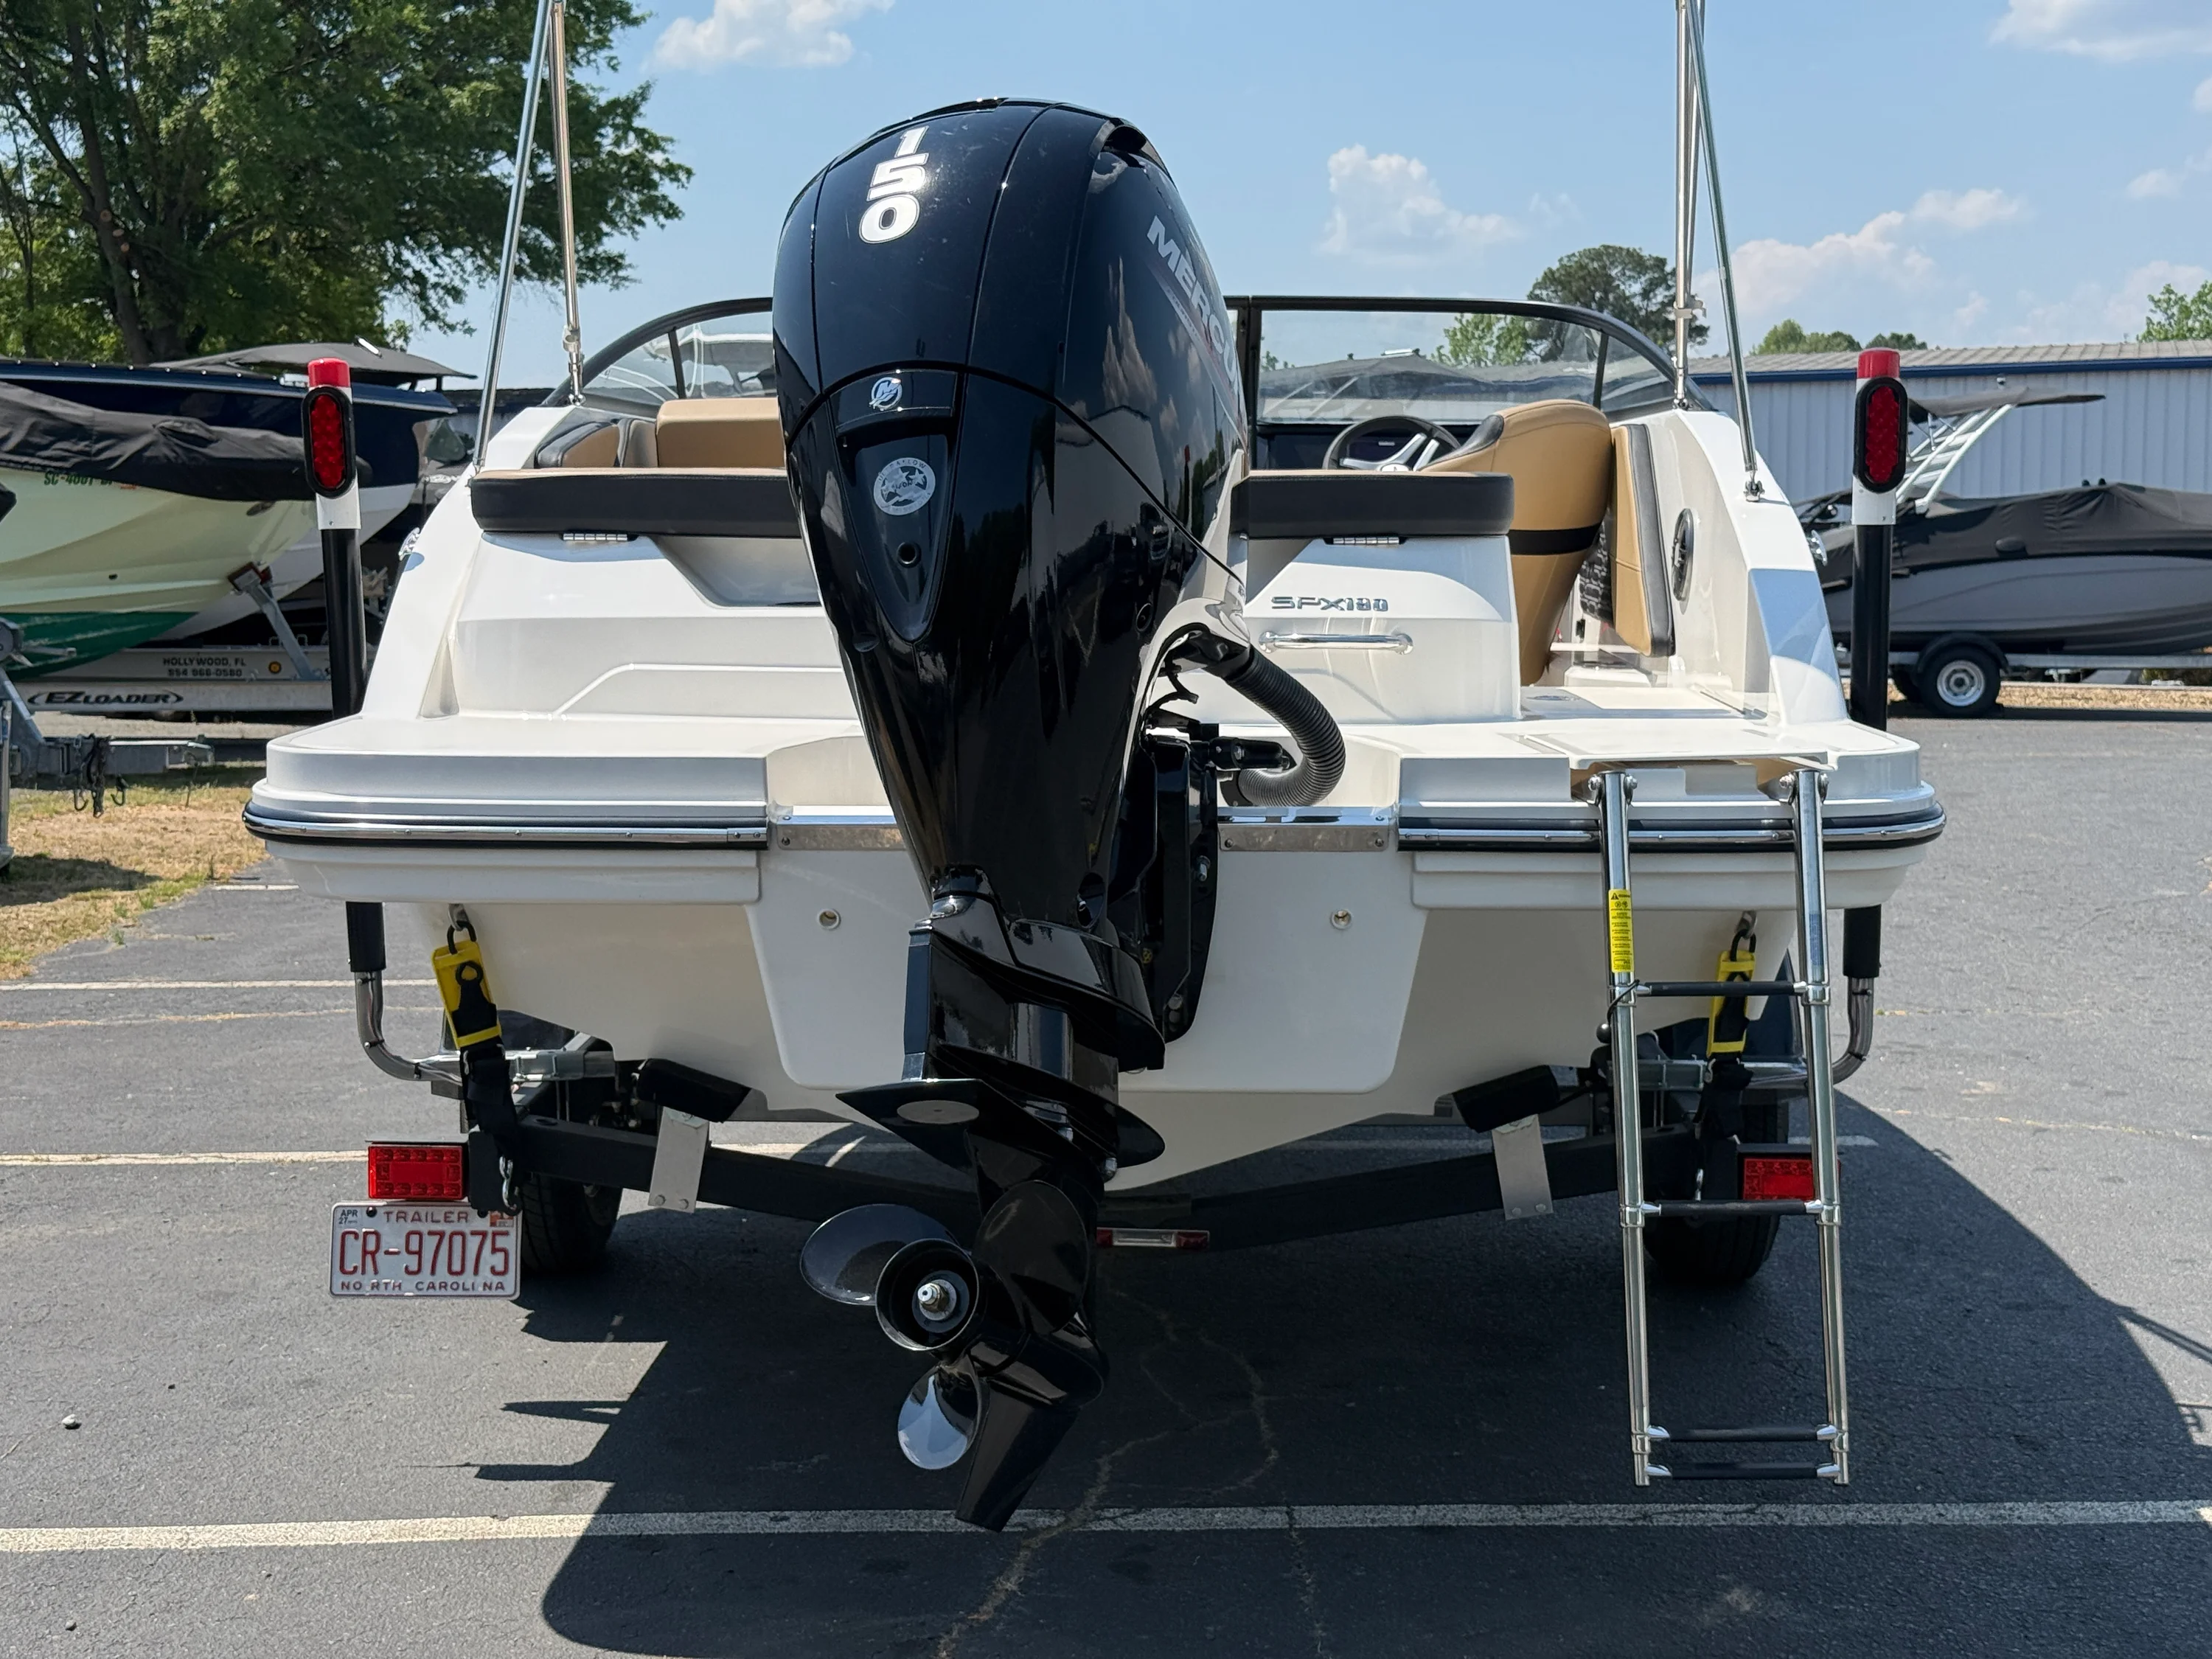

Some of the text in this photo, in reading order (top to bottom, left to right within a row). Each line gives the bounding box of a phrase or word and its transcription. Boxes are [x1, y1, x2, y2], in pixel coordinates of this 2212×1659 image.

[858, 125, 929, 244] 150
[1147, 215, 1239, 392] MERCU
[234, 657, 247, 667] FL
[339, 1217, 348, 1225] 27
[341, 1209, 469, 1223] APR TRAILER
[339, 1228, 510, 1276] CR-97075
[341, 1279, 505, 1291] NORTH CAROLINA
